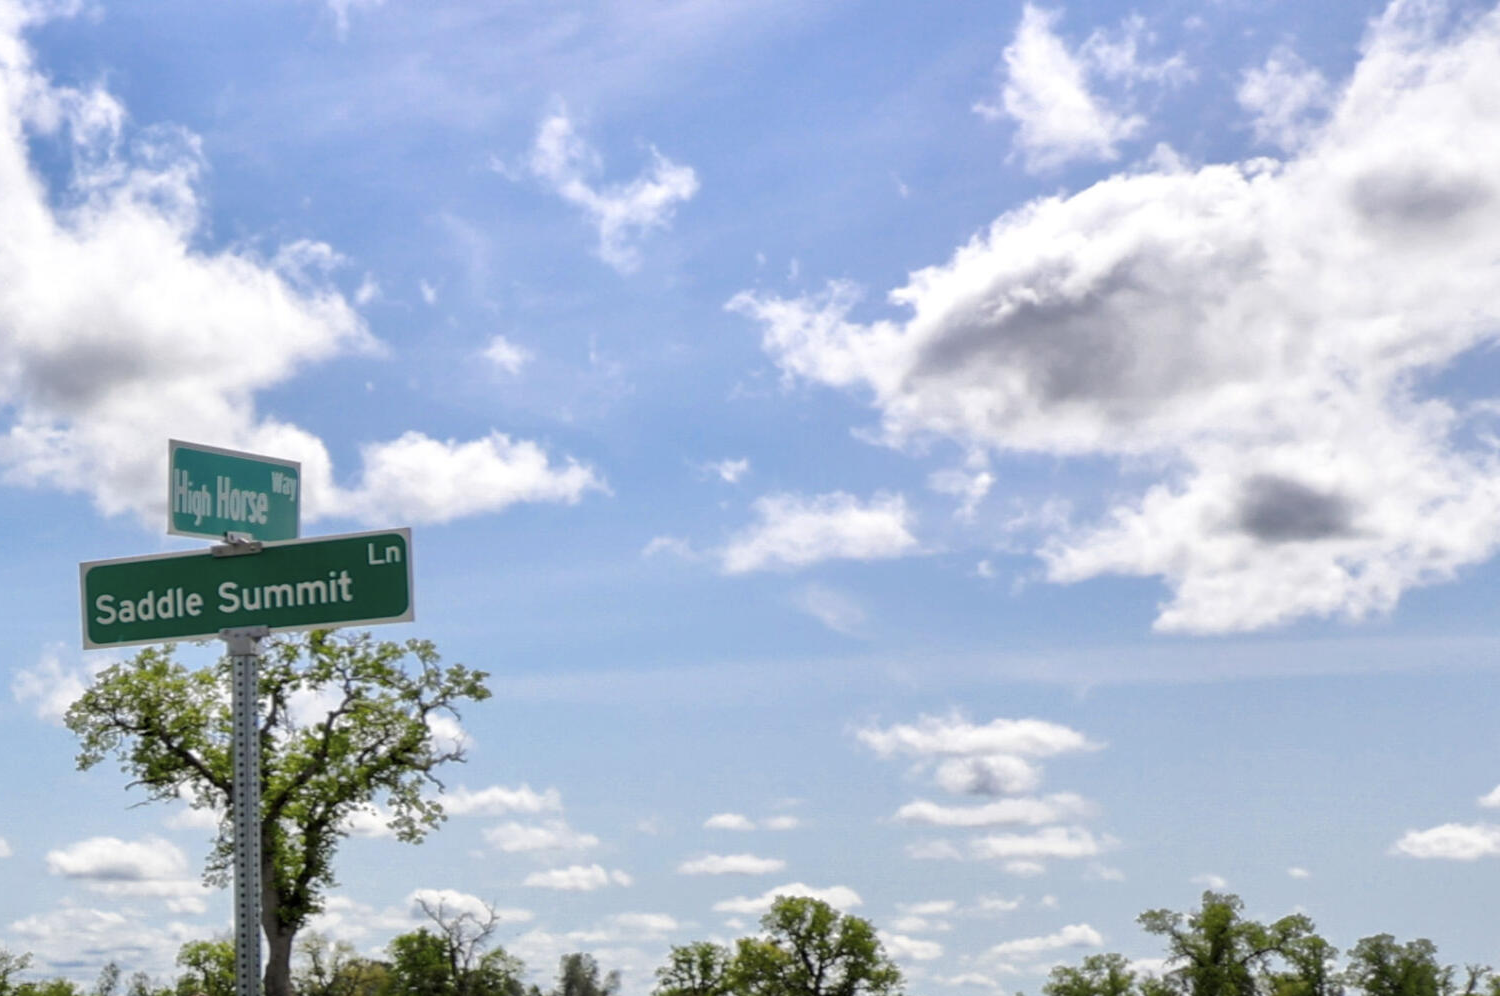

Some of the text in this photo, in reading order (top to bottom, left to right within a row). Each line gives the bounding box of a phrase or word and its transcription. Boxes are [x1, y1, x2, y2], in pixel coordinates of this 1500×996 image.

[173, 468, 268, 526] High Horse
[271, 471, 297, 501] Way
[368, 543, 401, 565] Ln
[95, 570, 353, 625] Saddle Summit
